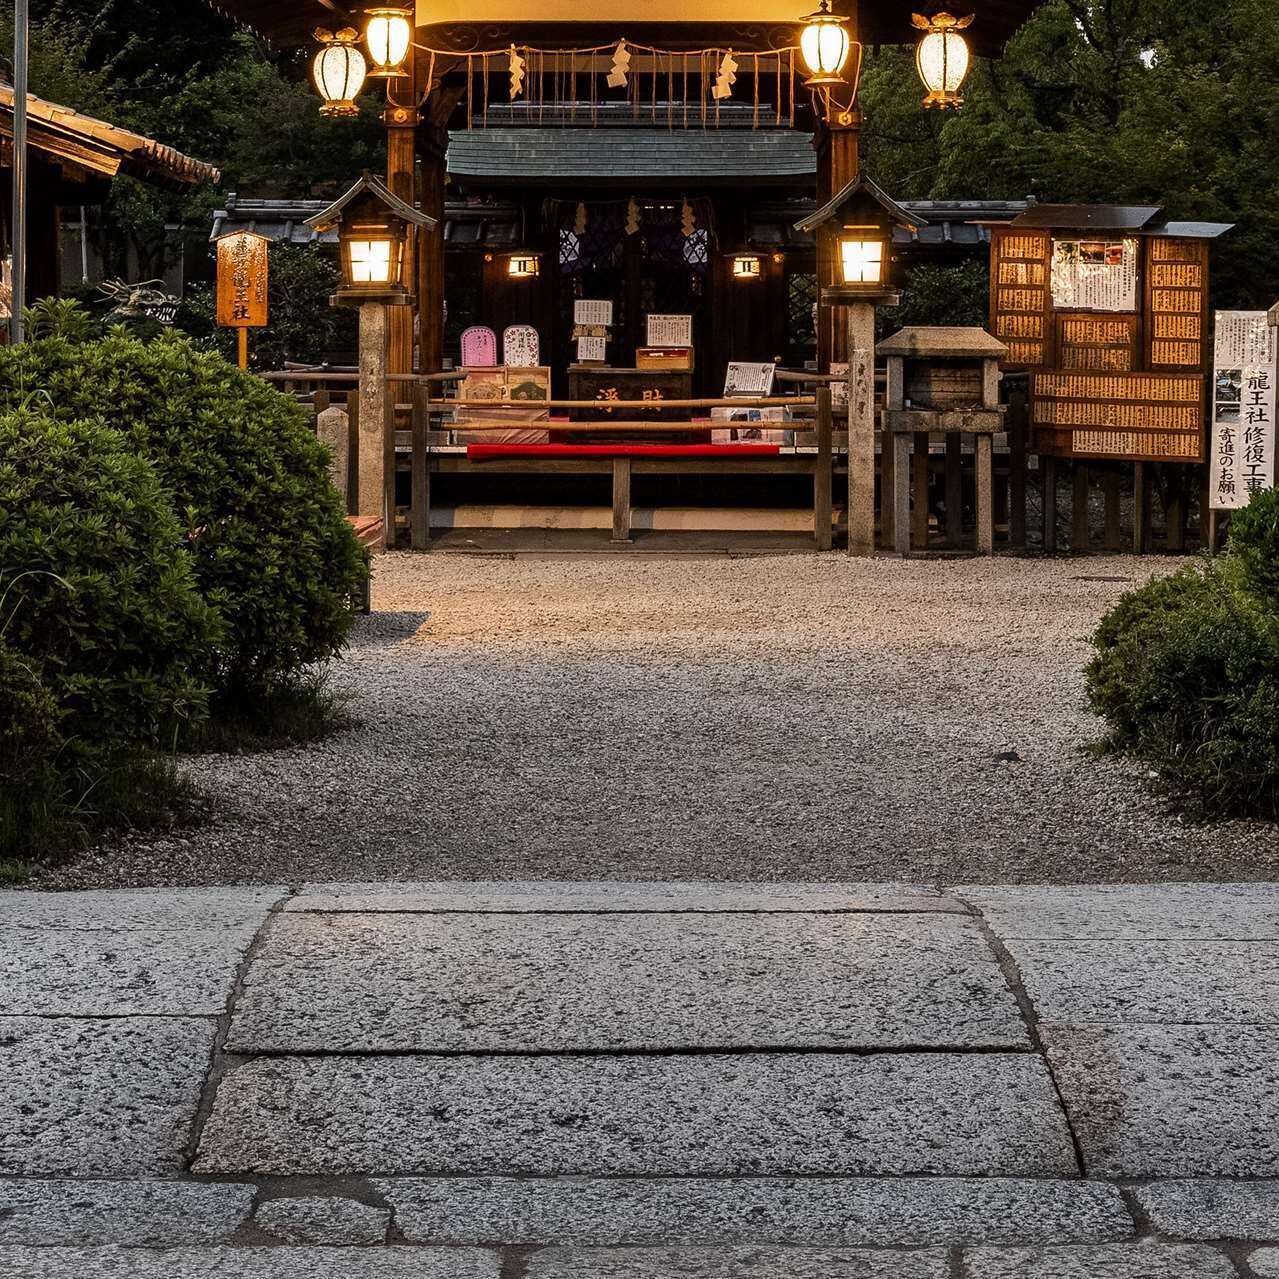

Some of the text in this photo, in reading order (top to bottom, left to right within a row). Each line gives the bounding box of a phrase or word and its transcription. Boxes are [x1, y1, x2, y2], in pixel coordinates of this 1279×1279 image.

[1217, 426, 1236, 505] 寄進のお願い
[1242, 370, 1270, 493] 龍王社修復工事
